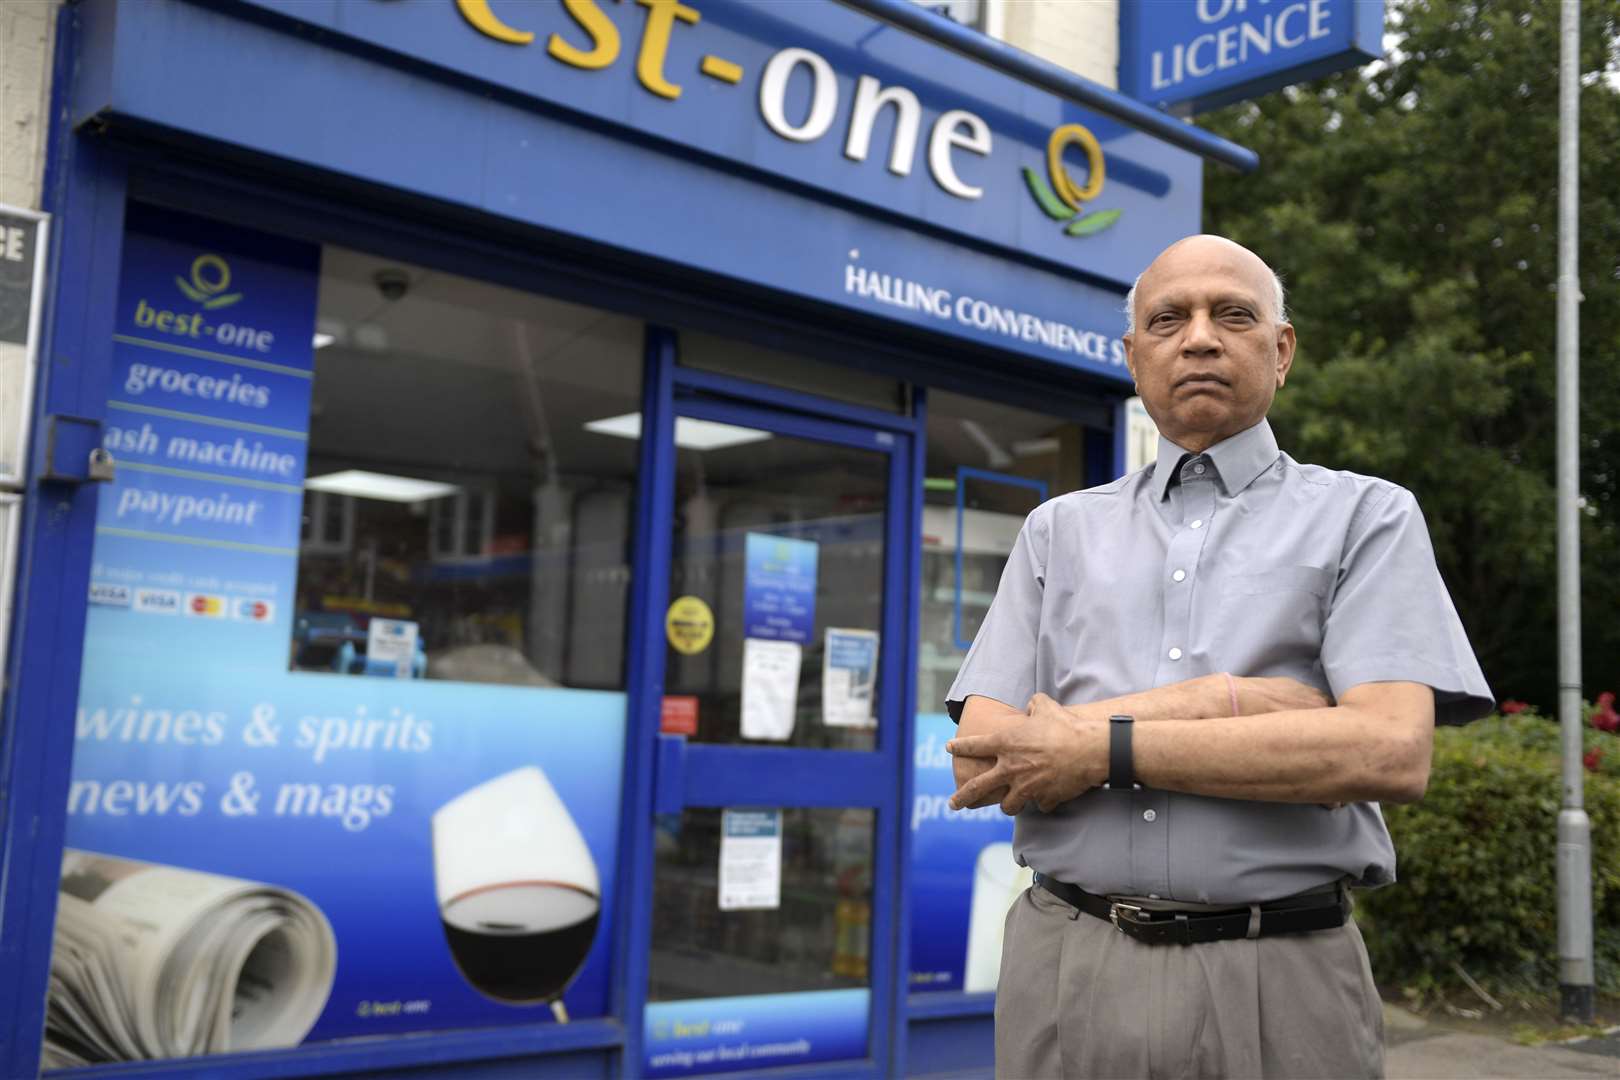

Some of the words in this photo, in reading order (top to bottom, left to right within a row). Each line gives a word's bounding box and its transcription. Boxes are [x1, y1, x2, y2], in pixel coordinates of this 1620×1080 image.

[1151, 0, 1331, 90] LICENCE
[378, 0, 992, 199] st-one
[0, 224, 25, 262] E
[134, 299, 275, 353] best-one
[845, 264, 952, 319] HALLING
[955, 296, 1108, 361] CONVENIENCE
[1111, 339, 1128, 367] S
[124, 361, 271, 408] groceries
[103, 421, 160, 456] ash
[167, 434, 297, 475] machine
[117, 484, 260, 527] paypoint
[75, 695, 227, 746] wines
[242, 702, 281, 748] &
[294, 706, 433, 764] spirits
[67, 778, 205, 816] news
[221, 771, 260, 816] &
[274, 782, 396, 832] mags
